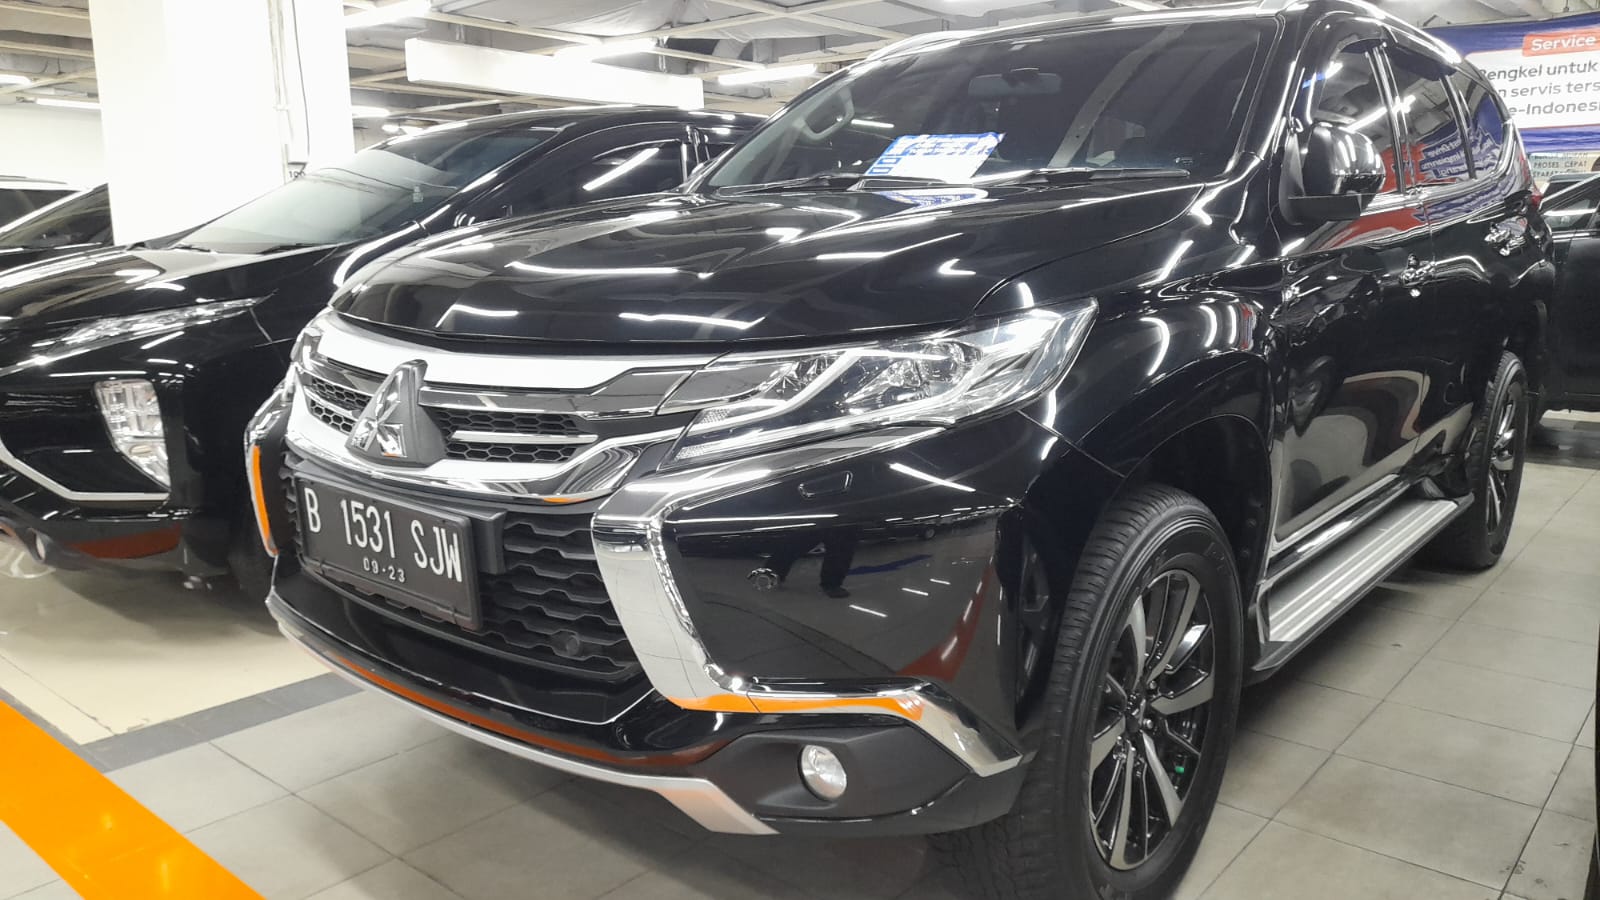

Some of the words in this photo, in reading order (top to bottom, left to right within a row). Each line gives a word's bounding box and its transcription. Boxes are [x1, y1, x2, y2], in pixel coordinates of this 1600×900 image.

[1531, 34, 1596, 50] Service
[1546, 60, 1598, 76] untuk
[1511, 83, 1561, 98] servis
[304, 487, 321, 533] B
[340, 499, 396, 559] 1531
[410, 519, 462, 583] SJW
